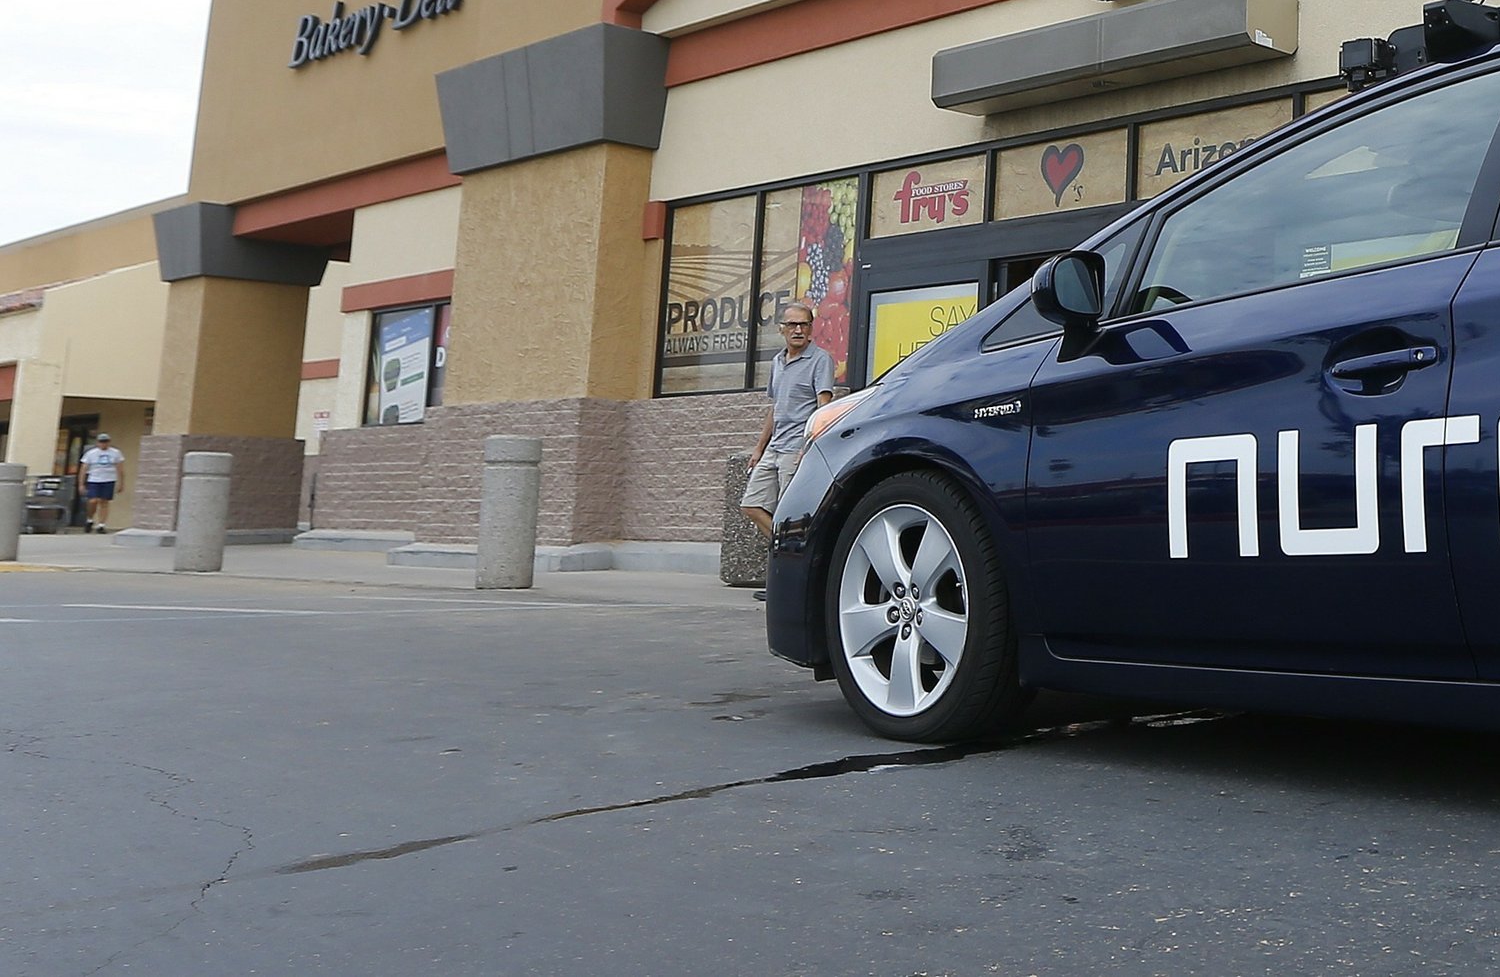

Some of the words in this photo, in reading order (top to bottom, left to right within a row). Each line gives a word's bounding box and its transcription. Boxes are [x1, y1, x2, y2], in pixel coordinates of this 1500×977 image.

[1155, 137, 1256, 176] Arizo
[893, 170, 970, 224] fry's
[911, 185, 933, 197] FOOD
[934, 180, 965, 194] STORES
[667, 290, 791, 335] PRODUCE
[665, 334, 710, 355] ALWAYS
[712, 332, 749, 351] FRESH
